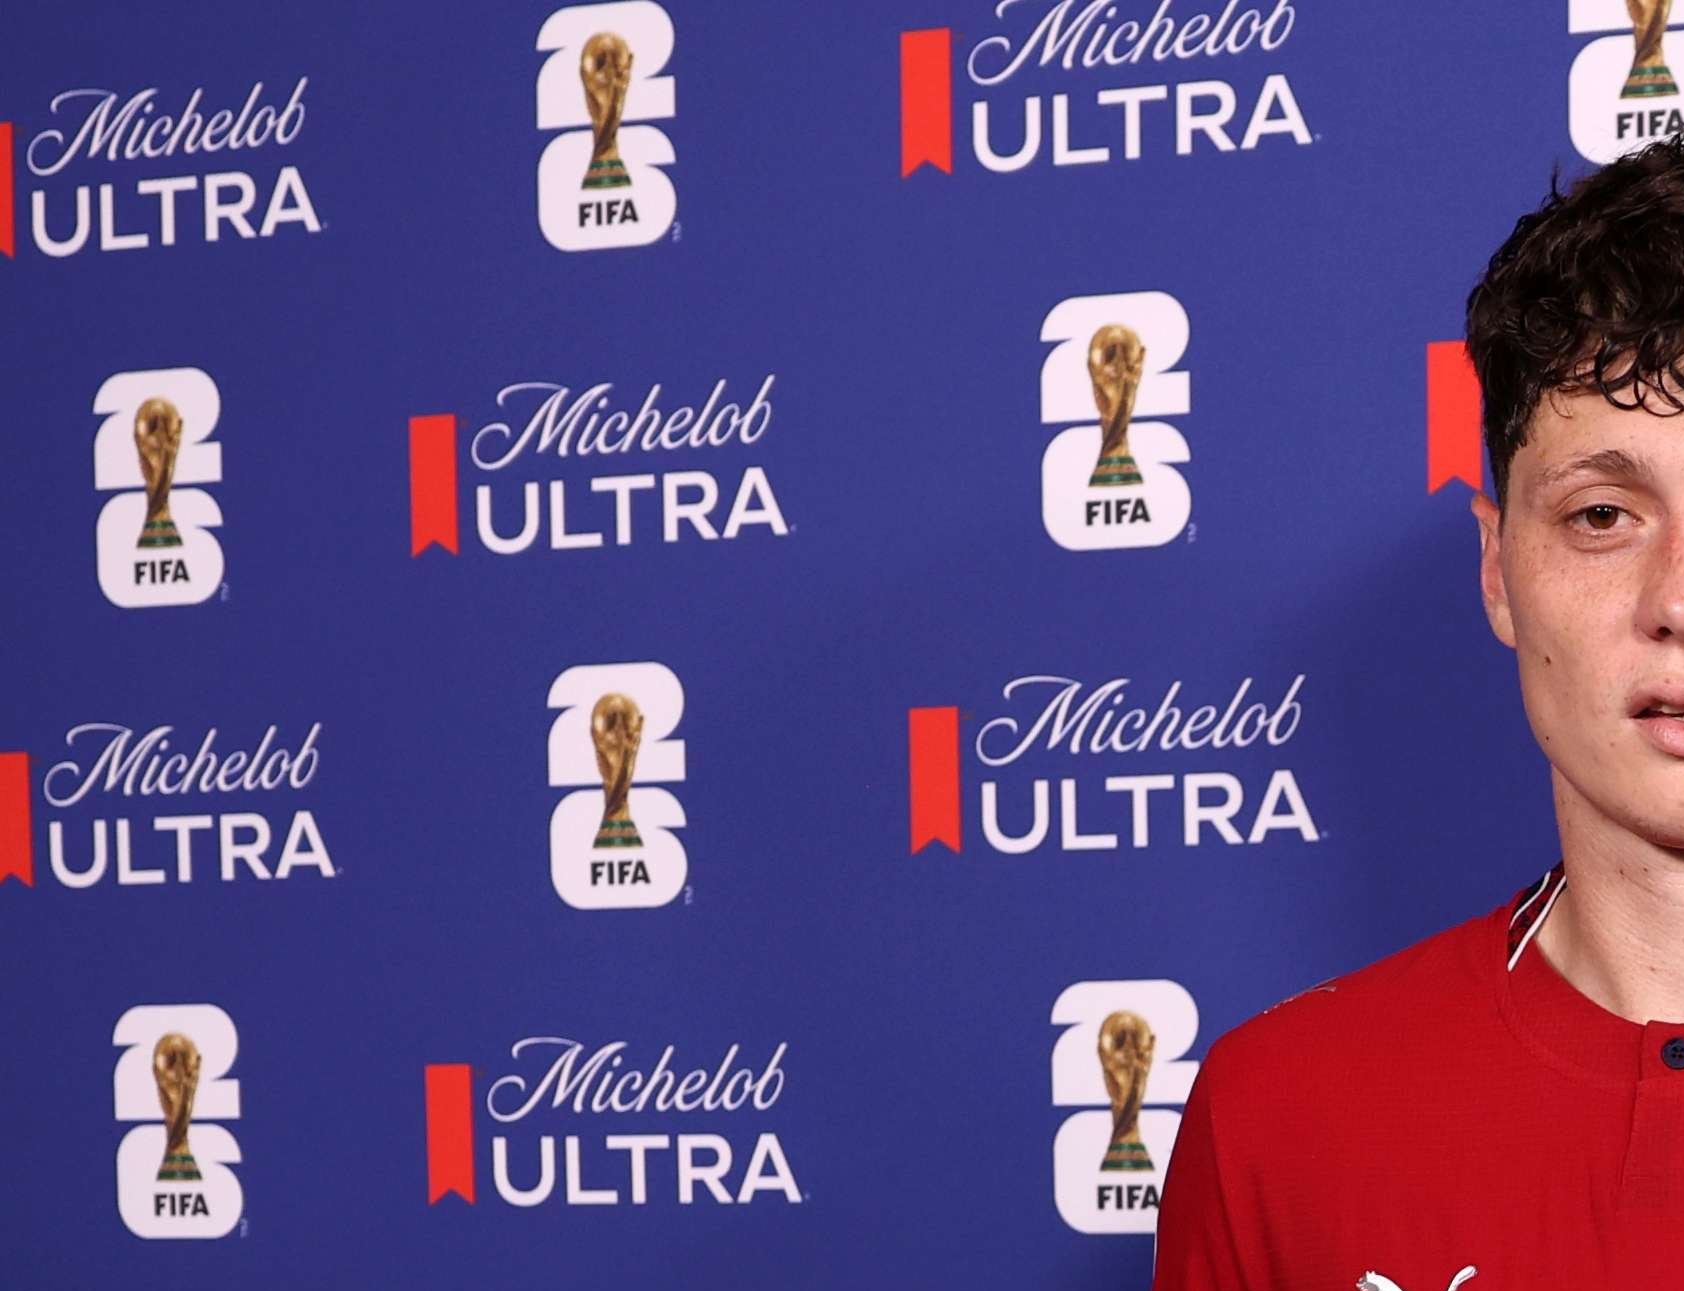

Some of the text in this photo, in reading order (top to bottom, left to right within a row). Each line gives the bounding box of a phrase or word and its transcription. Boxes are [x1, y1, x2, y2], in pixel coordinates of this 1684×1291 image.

[968, 0, 1295, 85] Michelob
[27, 77, 307, 176] Michelob
[973, 75, 1312, 172] ULTRA
[32, 166, 321, 257] ULTRA
[578, 199, 639, 228] FIFA
[471, 375, 775, 470] Michelob
[477, 467, 788, 554] ULTRA
[1085, 498, 1151, 527] FIFA
[134, 559, 190, 585] FIFA
[976, 675, 1305, 766] Michelob
[44, 723, 321, 807] Michelob
[49, 811, 336, 888] ULTRA
[982, 770, 1320, 854] ULTRA
[590, 860, 651, 886] FIFA
[487, 1037, 787, 1122] Michelob
[154, 1193, 210, 1217] FIFA
[493, 1133, 802, 1207] ULTRA
[1097, 1184, 1160, 1210] FIFA
